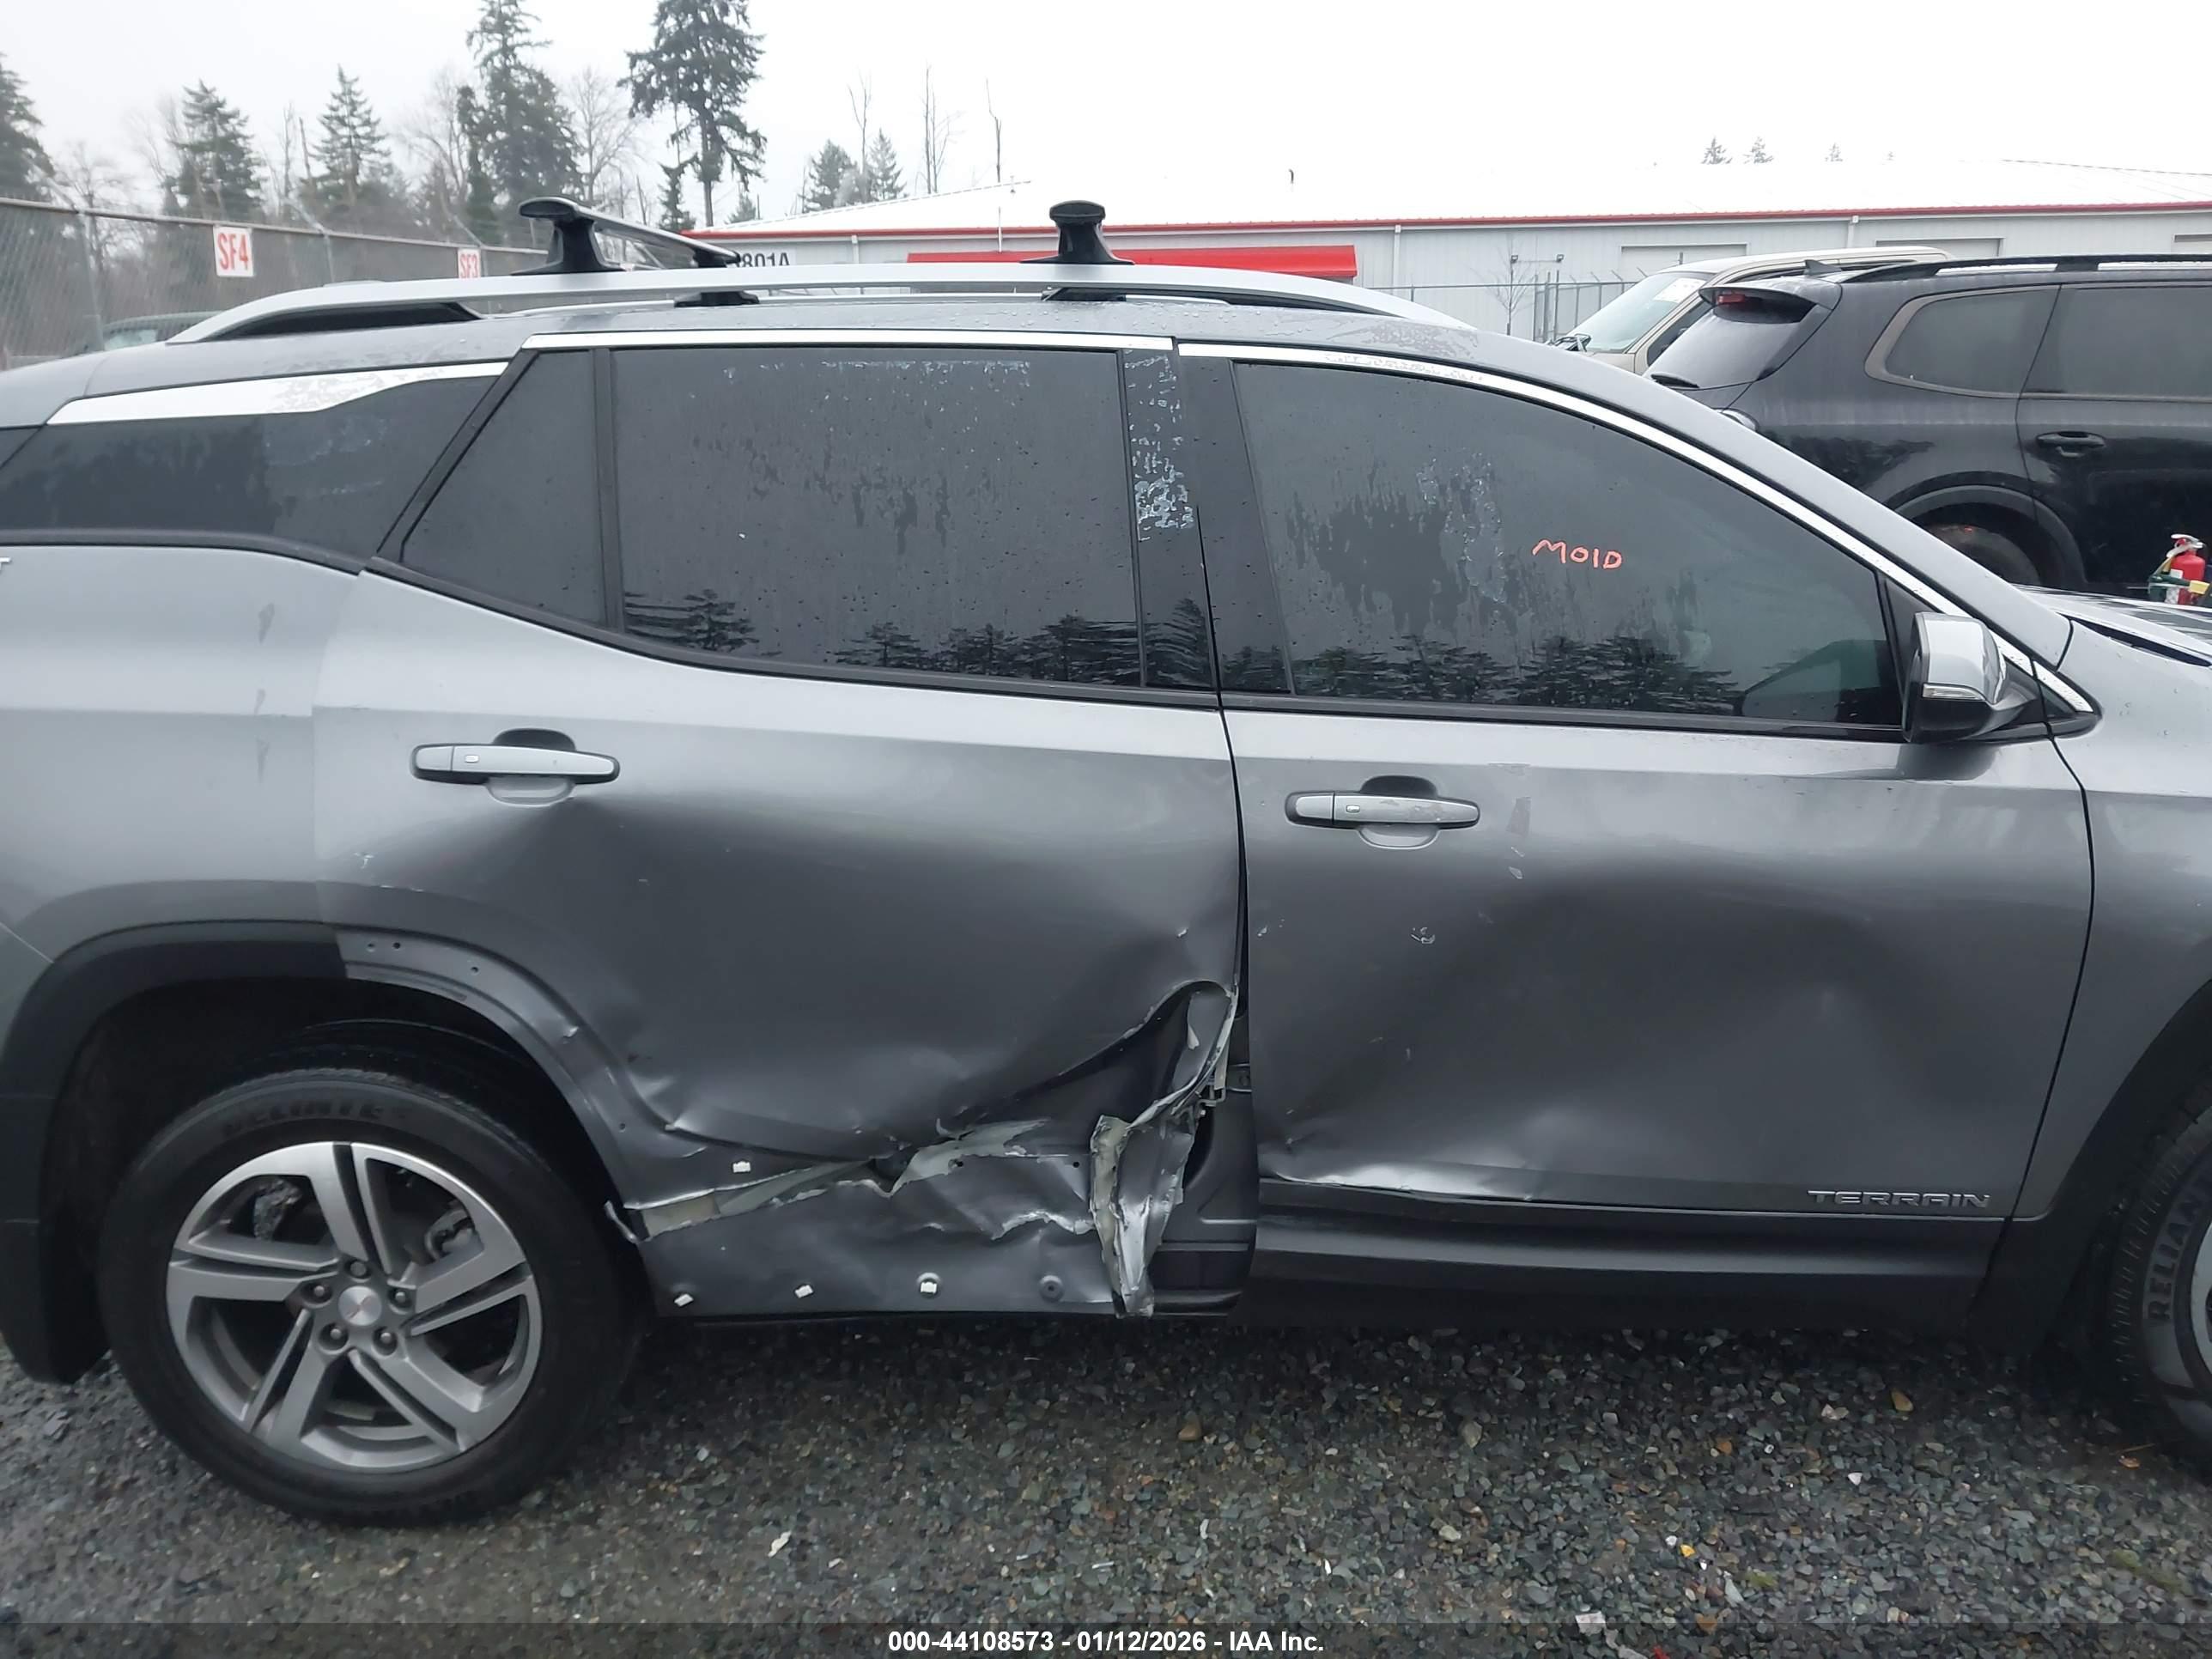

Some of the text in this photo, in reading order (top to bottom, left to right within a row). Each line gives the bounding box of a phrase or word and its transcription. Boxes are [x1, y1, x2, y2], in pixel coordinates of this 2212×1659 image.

[217, 233, 248, 270] SF4
[735, 252, 790, 268] 801A
[460, 253, 477, 278] SF3
[1807, 1190, 1990, 1208] TERRAIN
